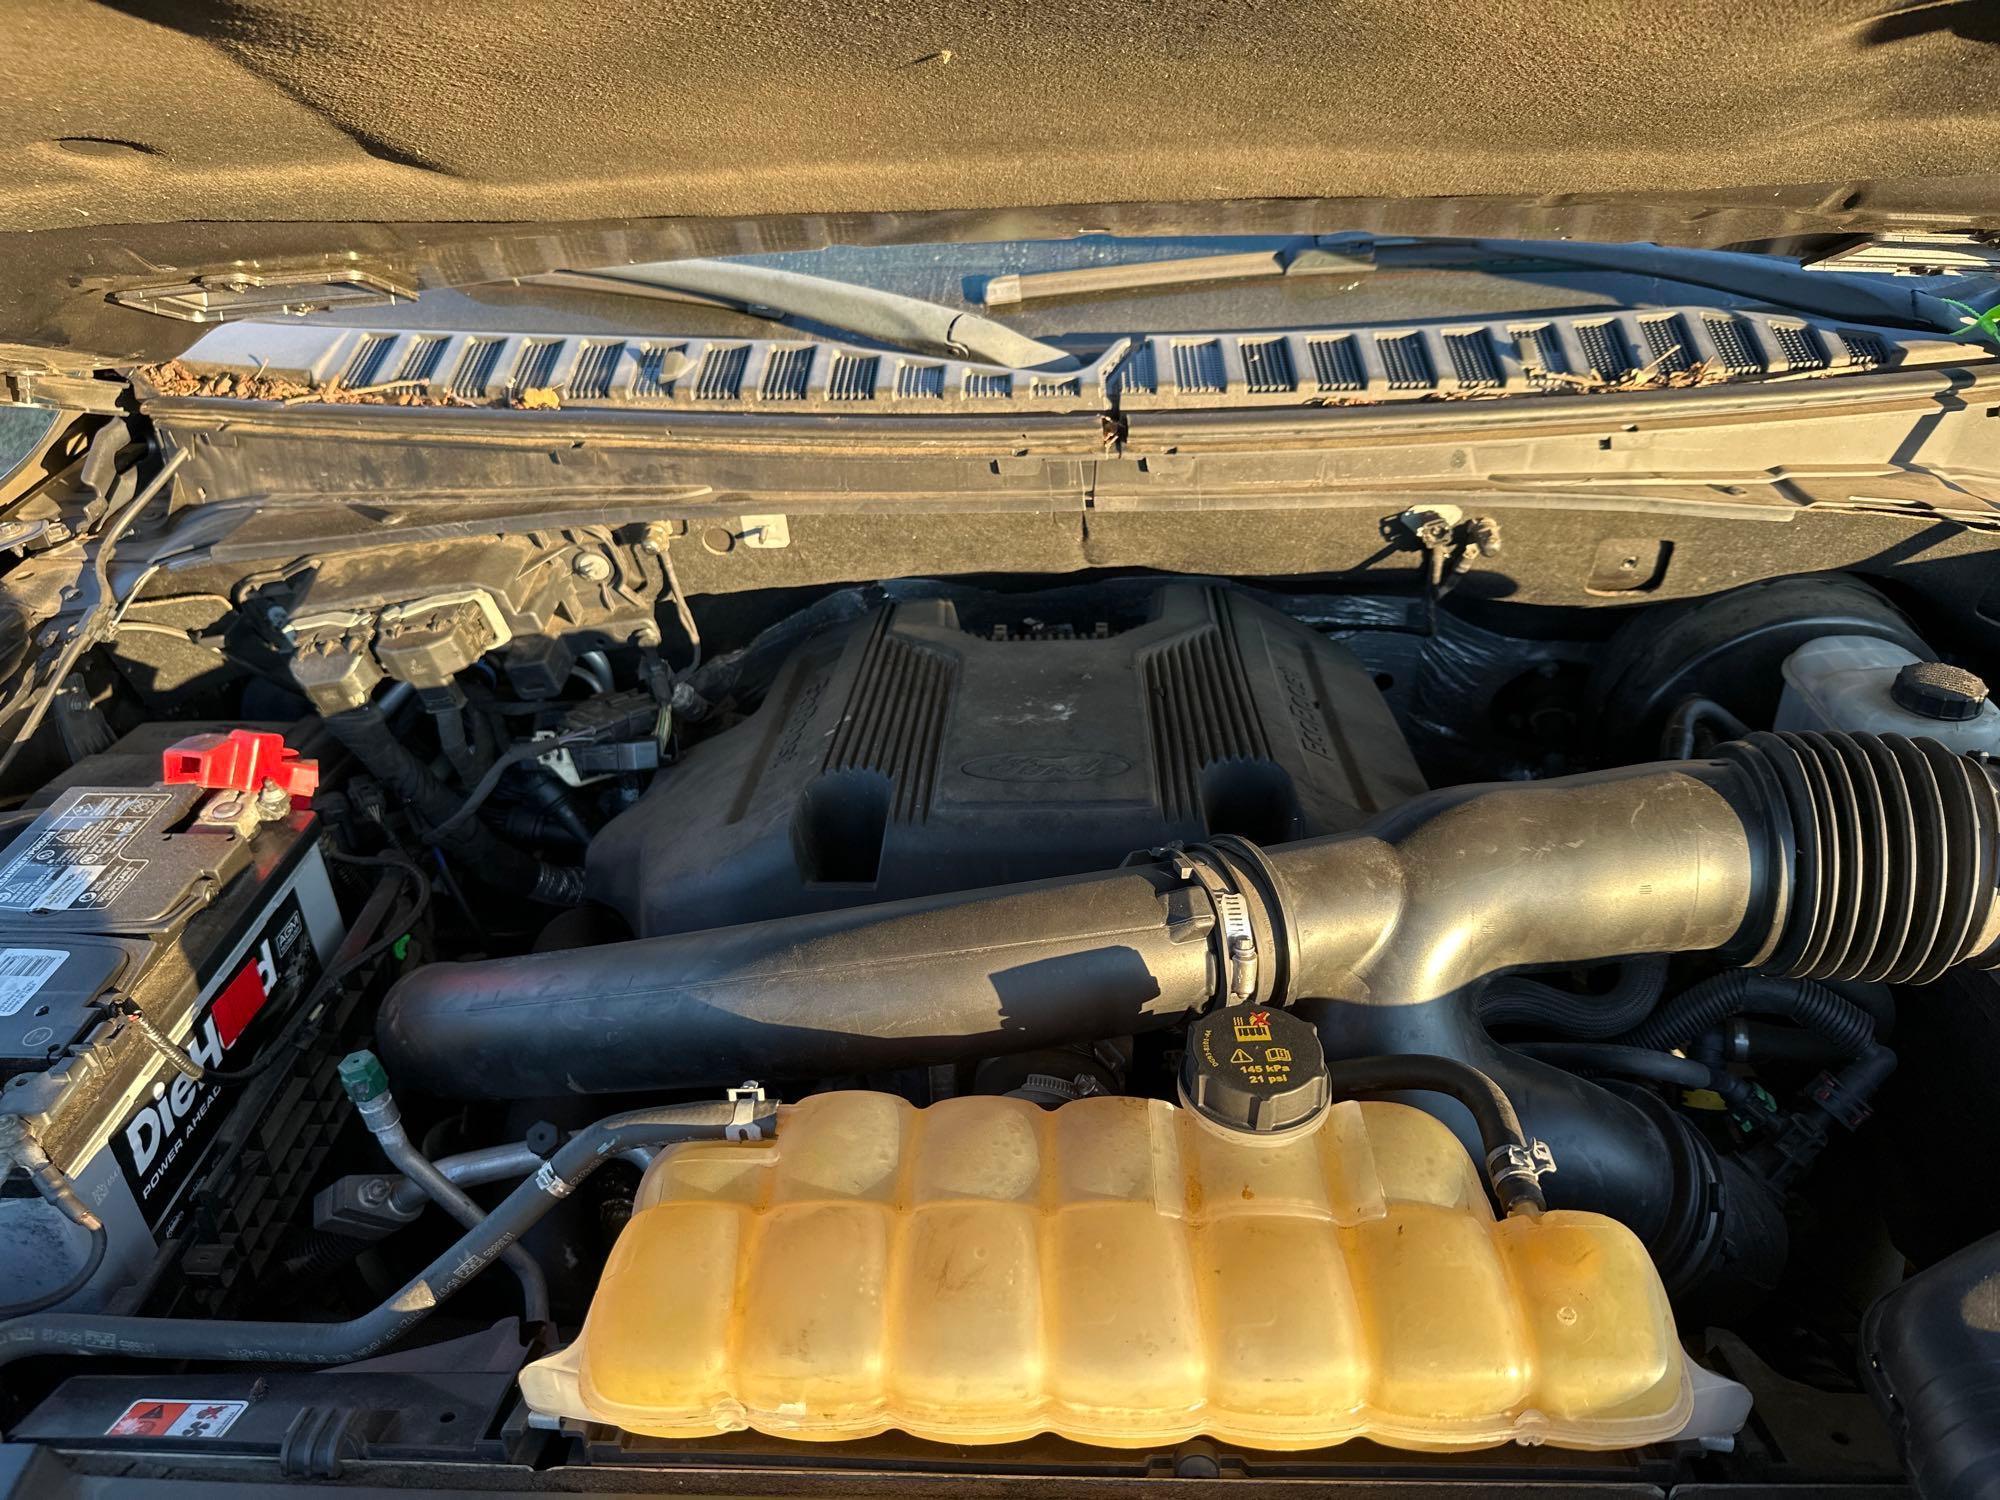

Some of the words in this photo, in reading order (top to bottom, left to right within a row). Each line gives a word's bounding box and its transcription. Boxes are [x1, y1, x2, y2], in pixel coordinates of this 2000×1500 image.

[279, 915, 299, 946] AGM
[126, 938, 278, 1177] DieHd
[1240, 1065, 1263, 1073] 145
[1265, 1064, 1290, 1073] kPa
[1249, 1075, 1264, 1083] 21
[1268, 1074, 1287, 1084] psi
[143, 1140, 184, 1199] POWER
